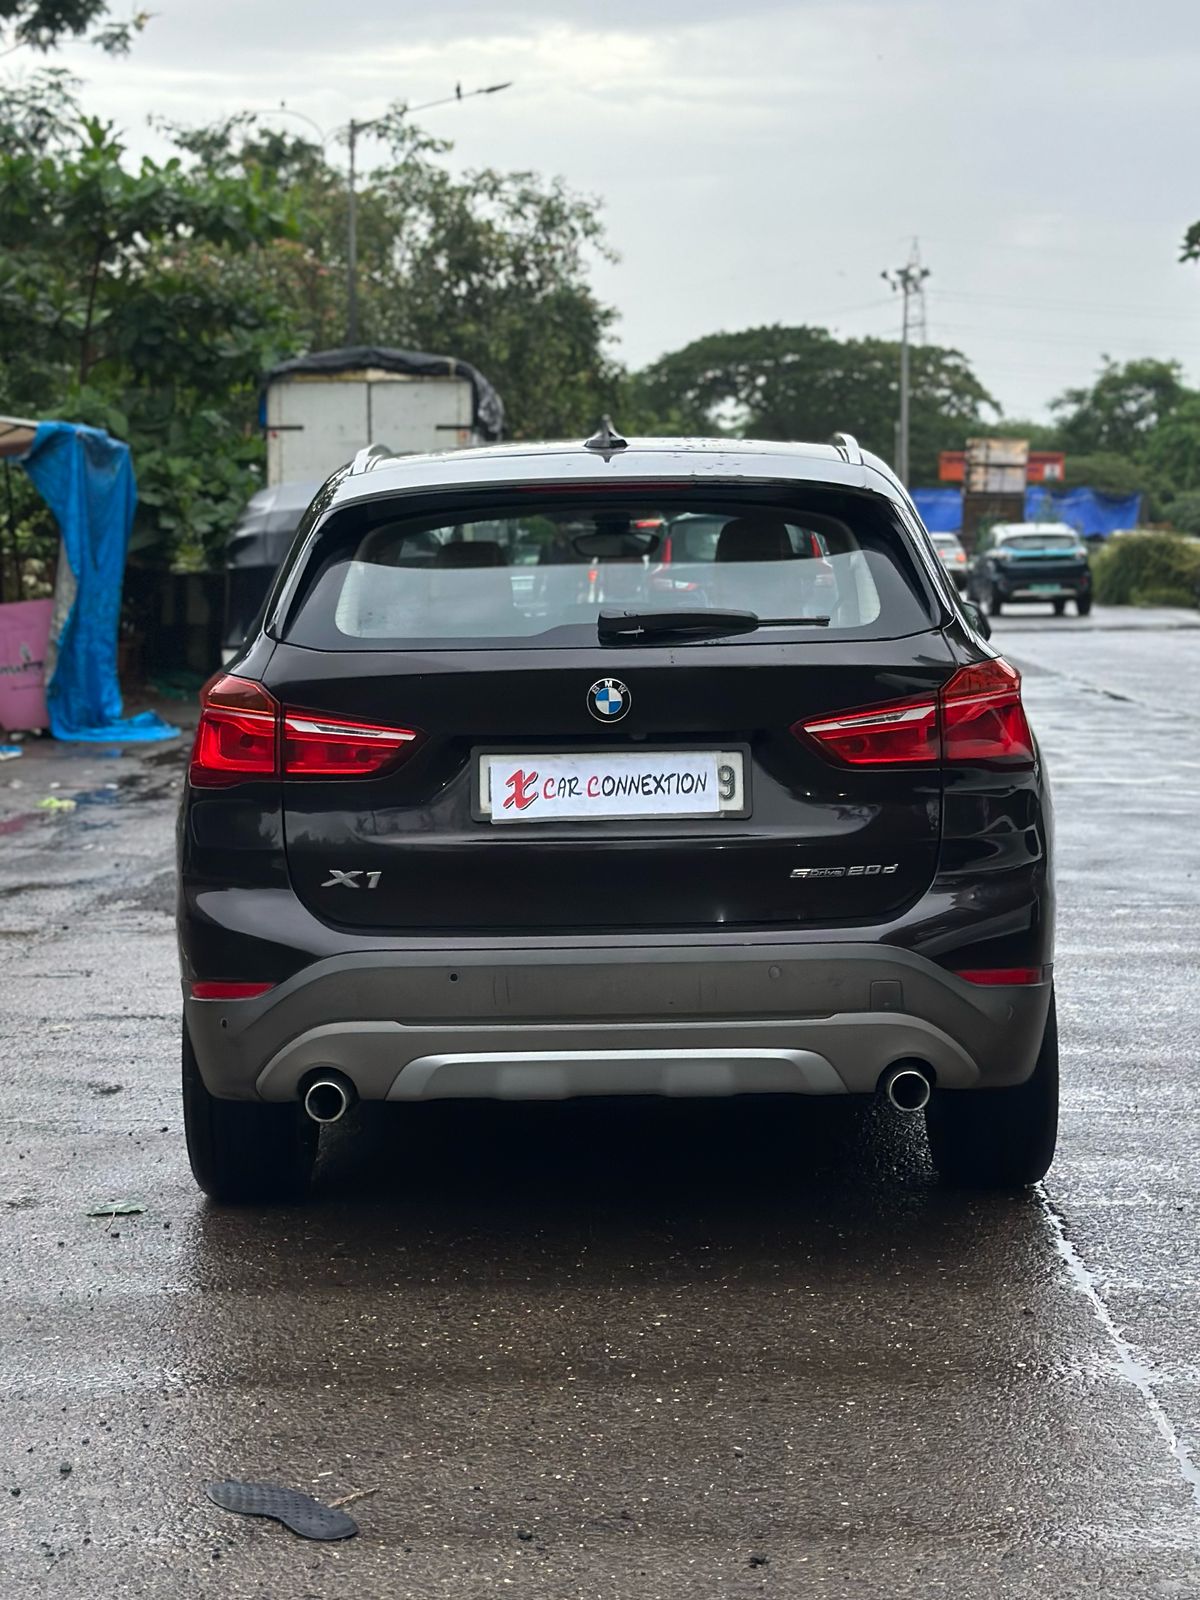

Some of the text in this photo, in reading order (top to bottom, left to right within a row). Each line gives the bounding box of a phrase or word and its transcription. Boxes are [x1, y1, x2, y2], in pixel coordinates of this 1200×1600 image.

[591, 680, 628, 695] BMW
[543, 776, 582, 799] CAR
[587, 771, 708, 798] CONNEXTION
[718, 765, 736, 801] 9
[320, 869, 382, 889] X1
